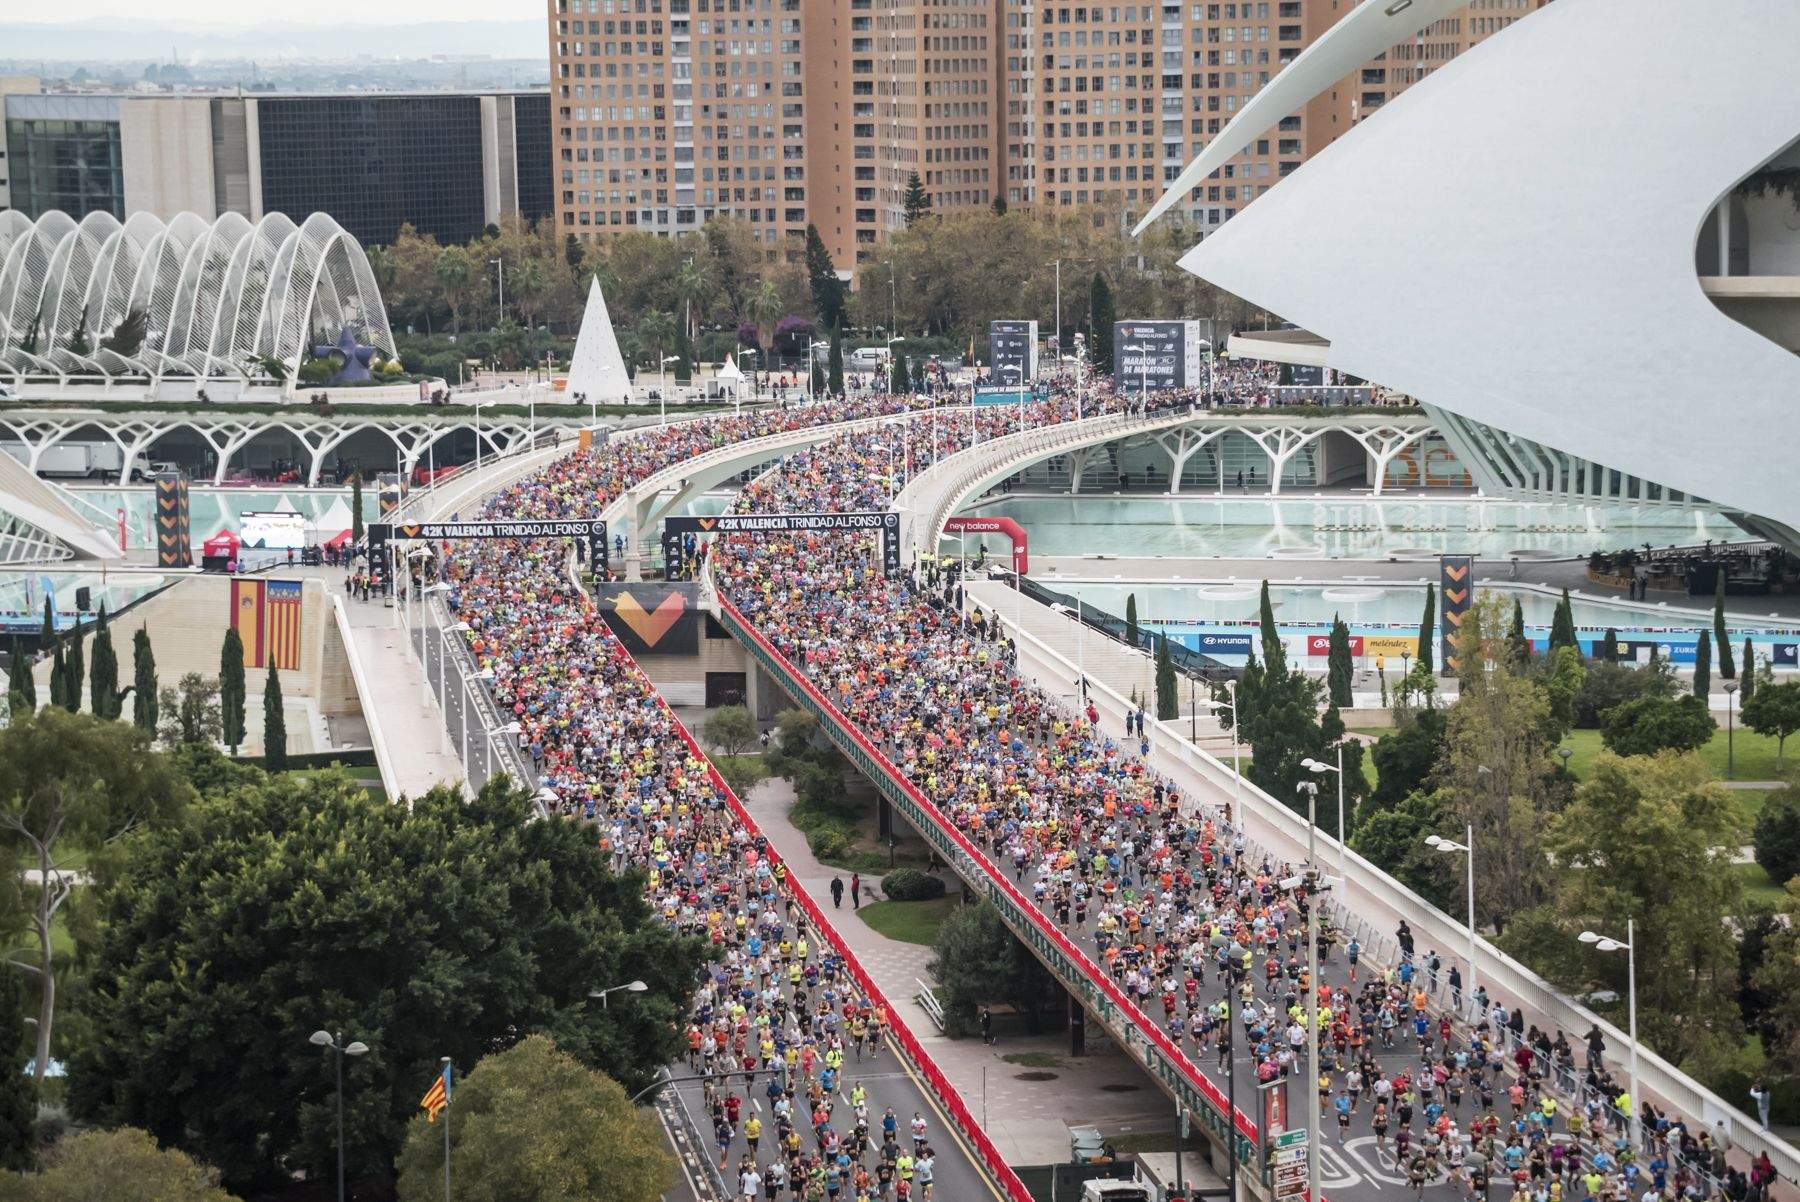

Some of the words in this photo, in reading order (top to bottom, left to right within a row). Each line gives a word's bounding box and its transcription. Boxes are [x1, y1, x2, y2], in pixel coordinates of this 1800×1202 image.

[1123, 365, 1133, 374] DE
[1134, 365, 1174, 374] MARATONES
[718, 518, 739, 530] 42K
[740, 517, 788, 529] VALENCIA
[788, 517, 835, 528] TRINIDAD
[835, 515, 881, 527] ALFONSO
[967, 522, 1000, 530] balance
[421, 525, 444, 537] 42K
[444, 525, 494, 537] VALENCIA
[495, 524, 541, 536] TRINIDAD
[542, 523, 589, 535] ALFONSO
[1217, 637, 1250, 645] HYUNDAI
[1673, 646, 1697, 654] ZURIC
